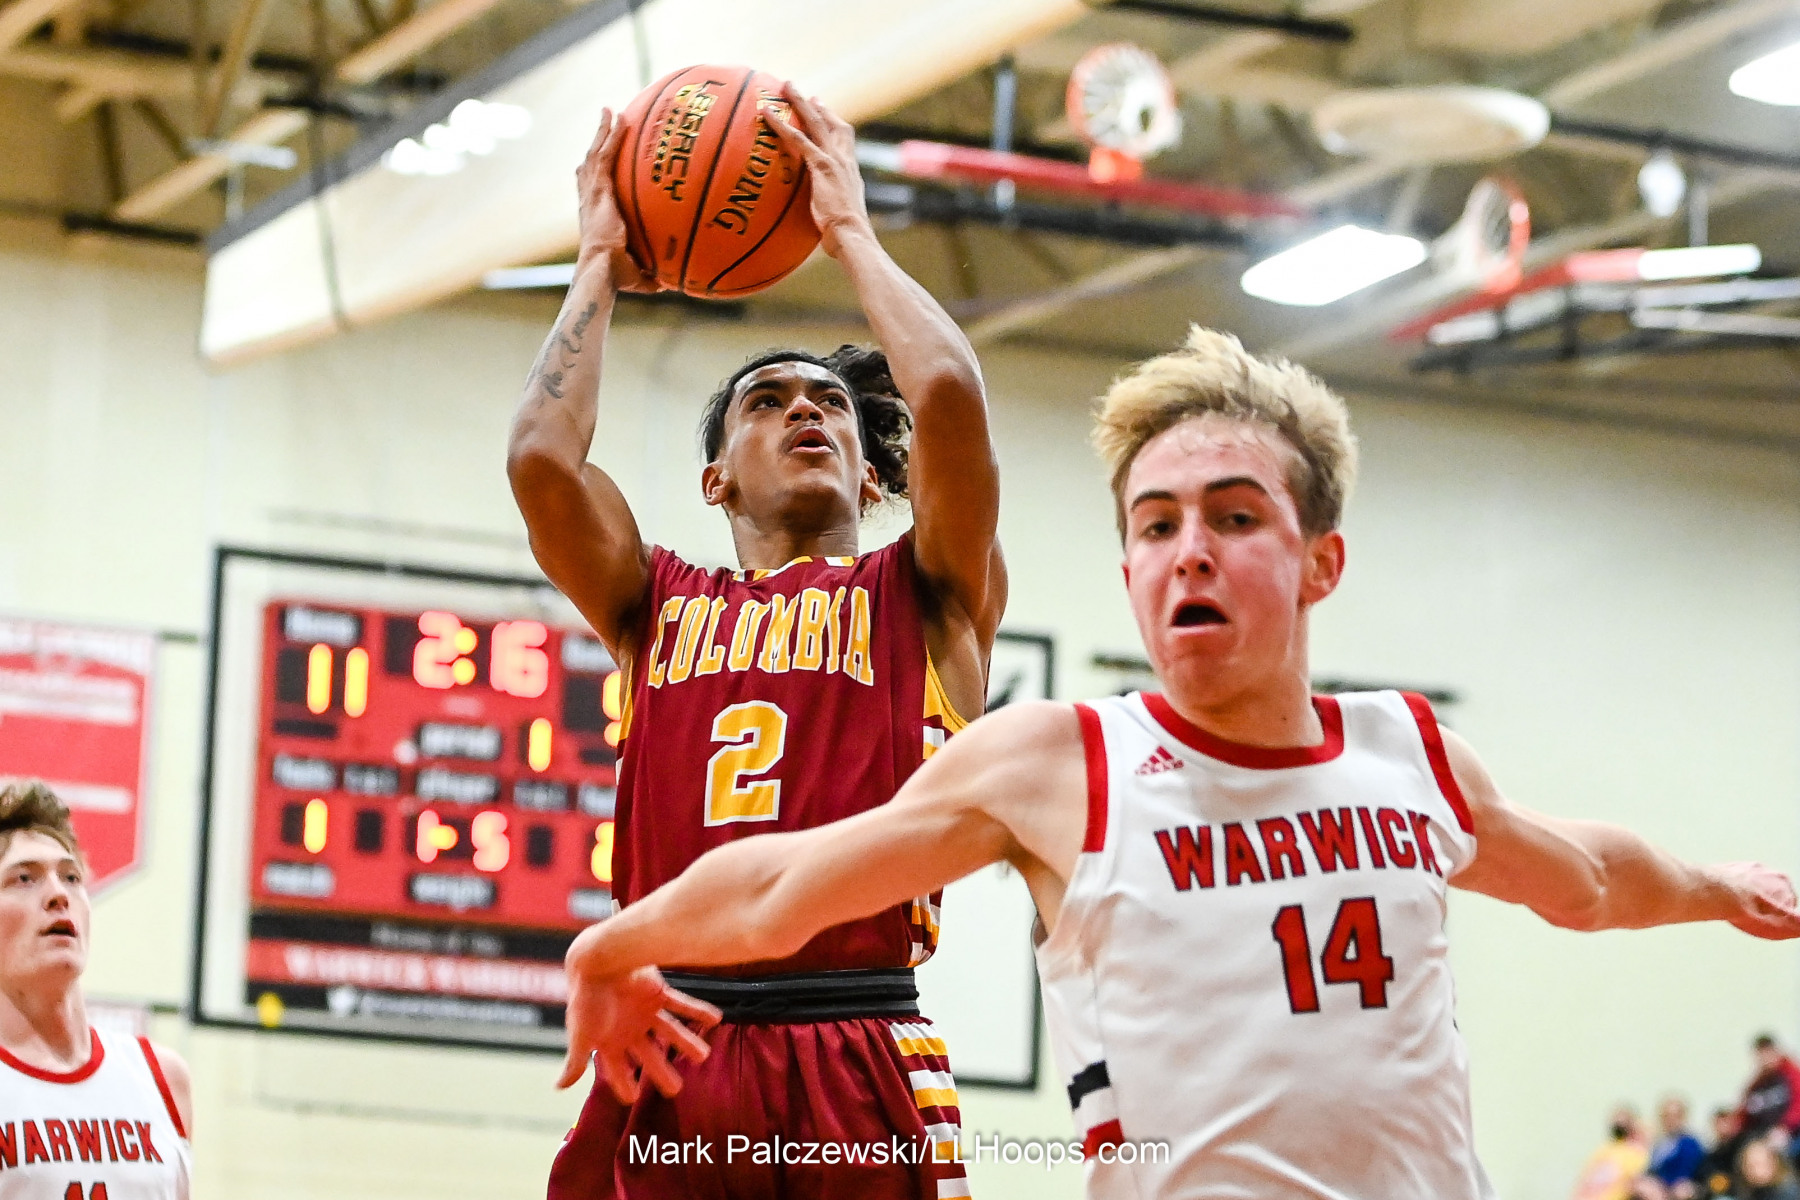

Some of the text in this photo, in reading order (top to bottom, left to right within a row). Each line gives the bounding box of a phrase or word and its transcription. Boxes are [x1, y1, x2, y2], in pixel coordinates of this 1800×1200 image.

[307, 643, 369, 718] 11
[413, 611, 549, 698] 2:16
[648, 586, 874, 689] COLUMBIA
[704, 700, 788, 827] 2
[1153, 806, 1443, 891] WARWICK
[1271, 896, 1394, 1014] 14
